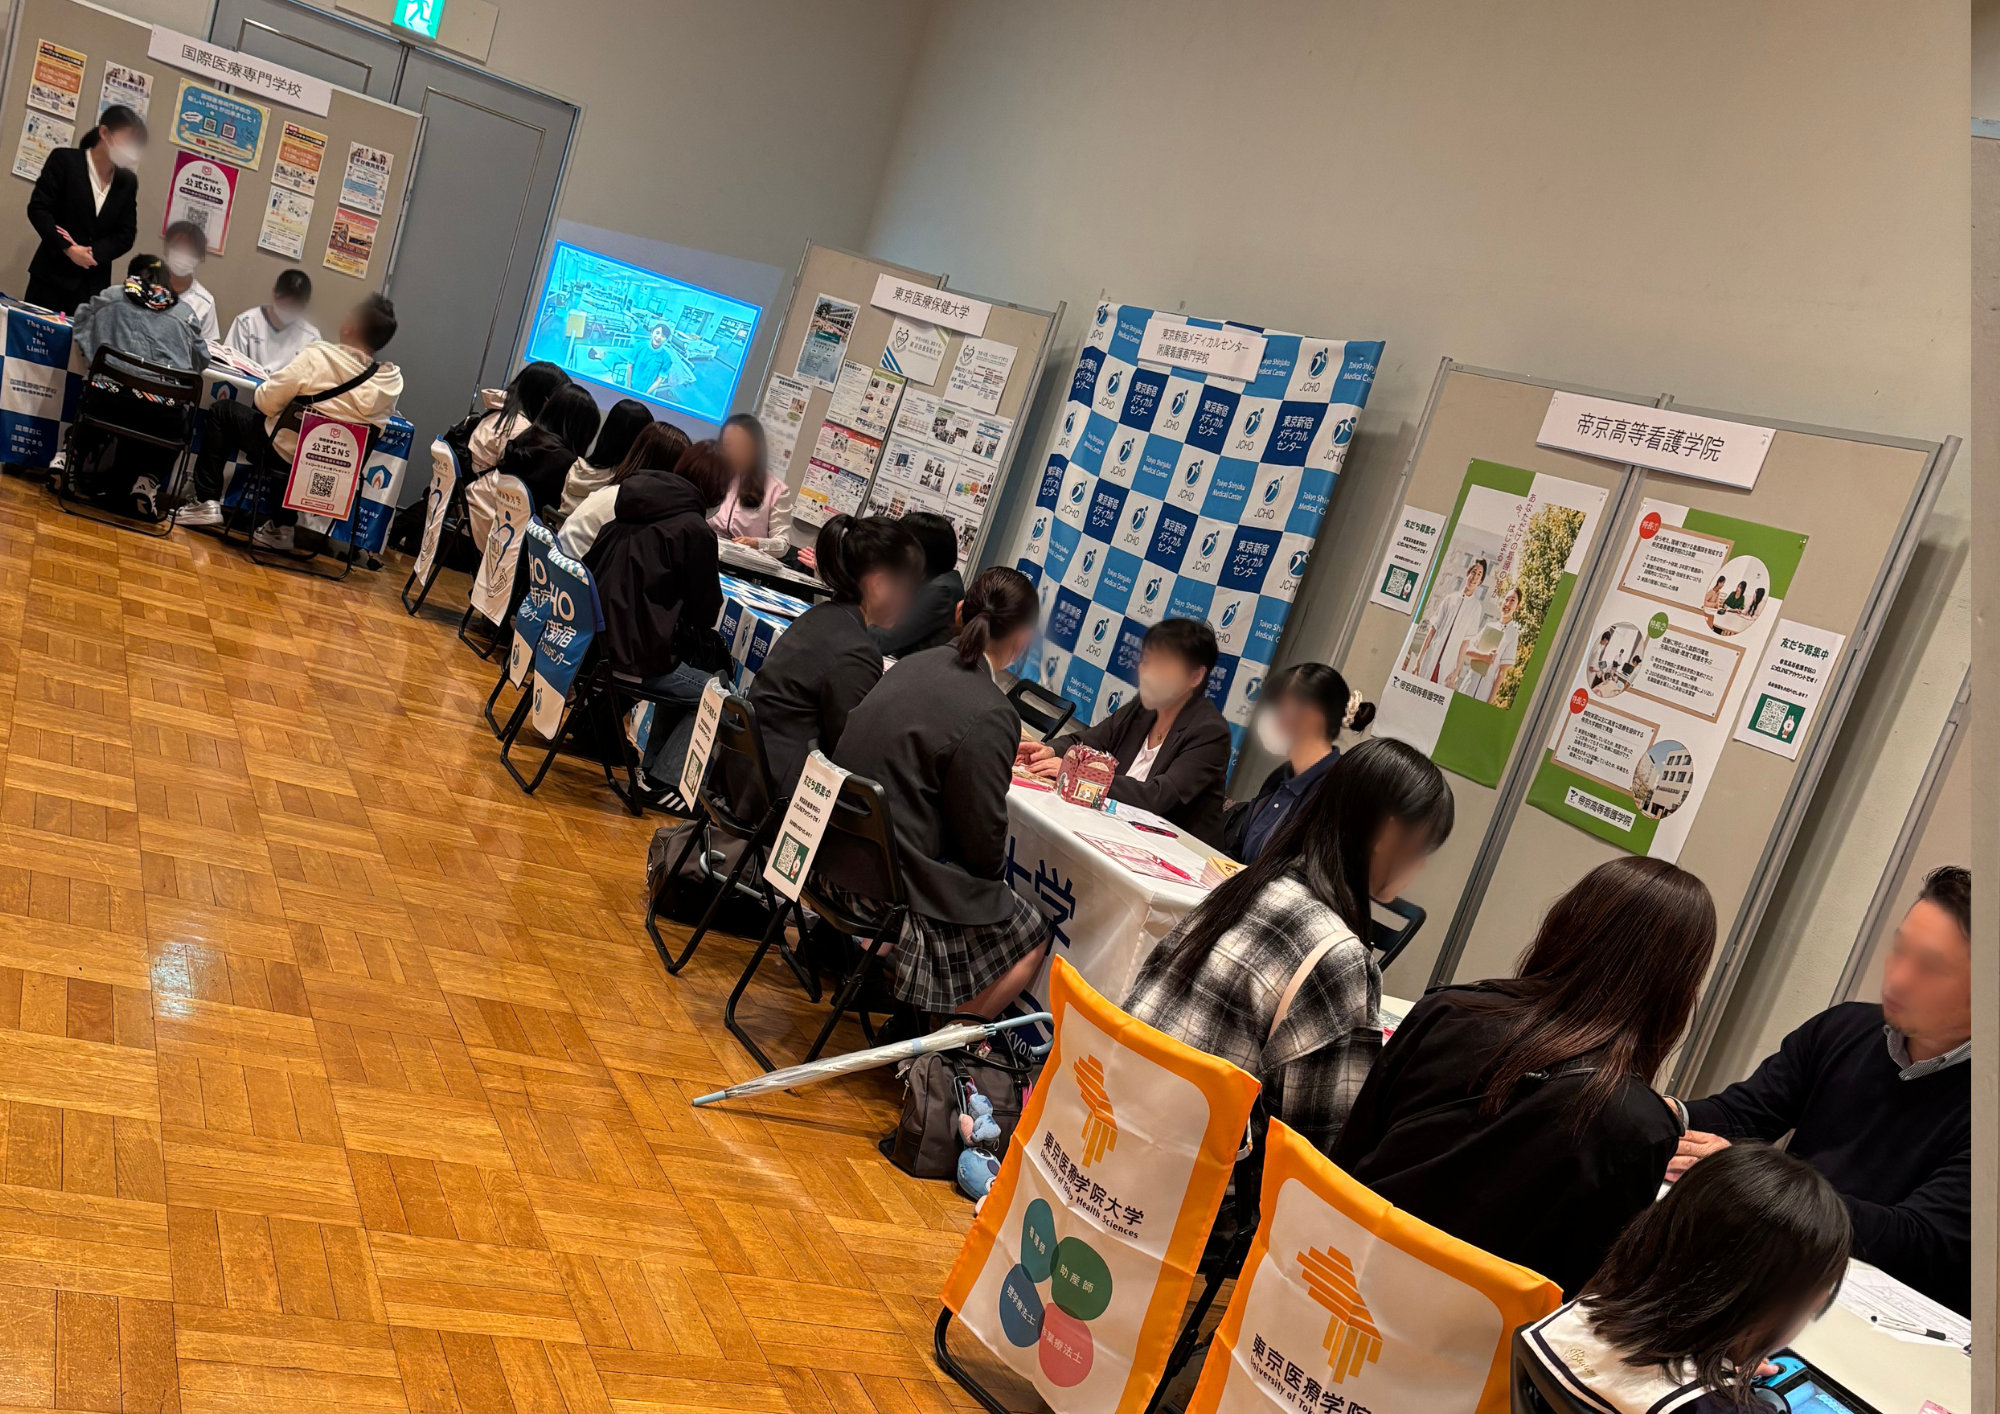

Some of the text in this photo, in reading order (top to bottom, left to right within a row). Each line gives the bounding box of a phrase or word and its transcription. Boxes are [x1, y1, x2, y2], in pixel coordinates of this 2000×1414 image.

[181, 44, 302, 99] 国際医療専門学校
[185, 177, 222, 195] 公式SNS
[893, 287, 970, 319] 東京医療保健大学
[26, 319, 55, 334] The sky
[32, 337, 46, 346] The
[1161, 328, 1250, 352] 東京新宿メディカルセンター
[1156, 343, 1210, 365] 附属看護専門学校
[1272, 358, 1291, 368] Shinjuku
[1349, 361, 1363, 369] Tokyo
[1272, 369, 1287, 377] Center
[1343, 373, 1362, 381] Medical
[1134, 381, 1158, 397] 東京新宿
[1300, 382, 1321, 393] JCHO
[1099, 397, 1115, 410] JCHO
[1131, 394, 1154, 408] メディカル
[1130, 404, 1149, 416] センター
[1202, 400, 1229, 418] 東京新宿
[1163, 418, 1180, 431] JCHO
[1199, 413, 1224, 429] メディカル
[1282, 415, 1314, 430] 東京新宿
[15, 424, 42, 436] 国際的に
[1198, 424, 1218, 437] センター
[1278, 429, 1308, 442] メディカル
[1576, 412, 1725, 462] 帝京高等看護学院
[312, 442, 350, 458] 公式SNS
[1235, 439, 1255, 451] JCHO
[1277, 440, 1302, 452] センター
[1145, 455, 1172, 470] Tokyo Shinjuku
[1110, 465, 1126, 478] JCHO
[1142, 464, 1169, 479] Medical Center
[1216, 478, 1246, 491] Tokyo Shinjuku
[1096, 492, 1119, 509] 東京新宿
[1178, 488, 1195, 501] JCHO
[1212, 489, 1243, 501] Medical Center
[1302, 491, 1317, 501] Tokyo
[1061, 504, 1080, 518] JCHO
[1093, 505, 1115, 520] メディカル
[1254, 507, 1275, 520] JCHO
[1298, 503, 1317, 513] Medical
[1092, 515, 1110, 528] センター
[1163, 518, 1188, 535] 東京新宿
[1404, 519, 1436, 536] 友だち募集中
[1123, 533, 1140, 546] JCHO
[1159, 531, 1182, 547] メディカル
[1158, 542, 1177, 555] センター
[1237, 540, 1270, 556] 東京新宿
[528, 551, 548, 585] HO
[1233, 554, 1264, 568] メディカル
[1107, 567, 1132, 585] Tokyo Shinjuku
[1233, 565, 1258, 578] センター
[1074, 575, 1089, 588] JCHO
[1103, 577, 1129, 593] Medical Center
[1279, 579, 1298, 592] JCH
[549, 581, 575, 622] HO
[1174, 598, 1186, 608] Tokyo
[1137, 604, 1154, 618] JCHO
[1259, 619, 1272, 630] Tokyo
[545, 619, 577, 648] 新宿
[1215, 631, 1231, 644] CHO
[1255, 630, 1274, 642] Medical
[1086, 643, 1101, 658] JCHO
[1780, 638, 1829, 660] 友だち募集中
[1070, 676, 1082, 687] Tokyo
[1400, 680, 1445, 705] 帝京高等看護学院
[803, 775, 832, 800] 友だち募集中
[1577, 795, 1633, 827] 帝京高等看護学院
[1043, 1130, 1144, 1226] 東京医療学院大学
[1040, 1149, 1059, 1180] University
[1058, 1176, 1063, 1185] of
[1076, 1196, 1100, 1219] Health
[1102, 1215, 1138, 1239] Sciences
[1060, 1264, 1094, 1293] 助産師
[1007, 1284, 1036, 1326] 理学療法士
[1250, 1355, 1296, 1403] University of
